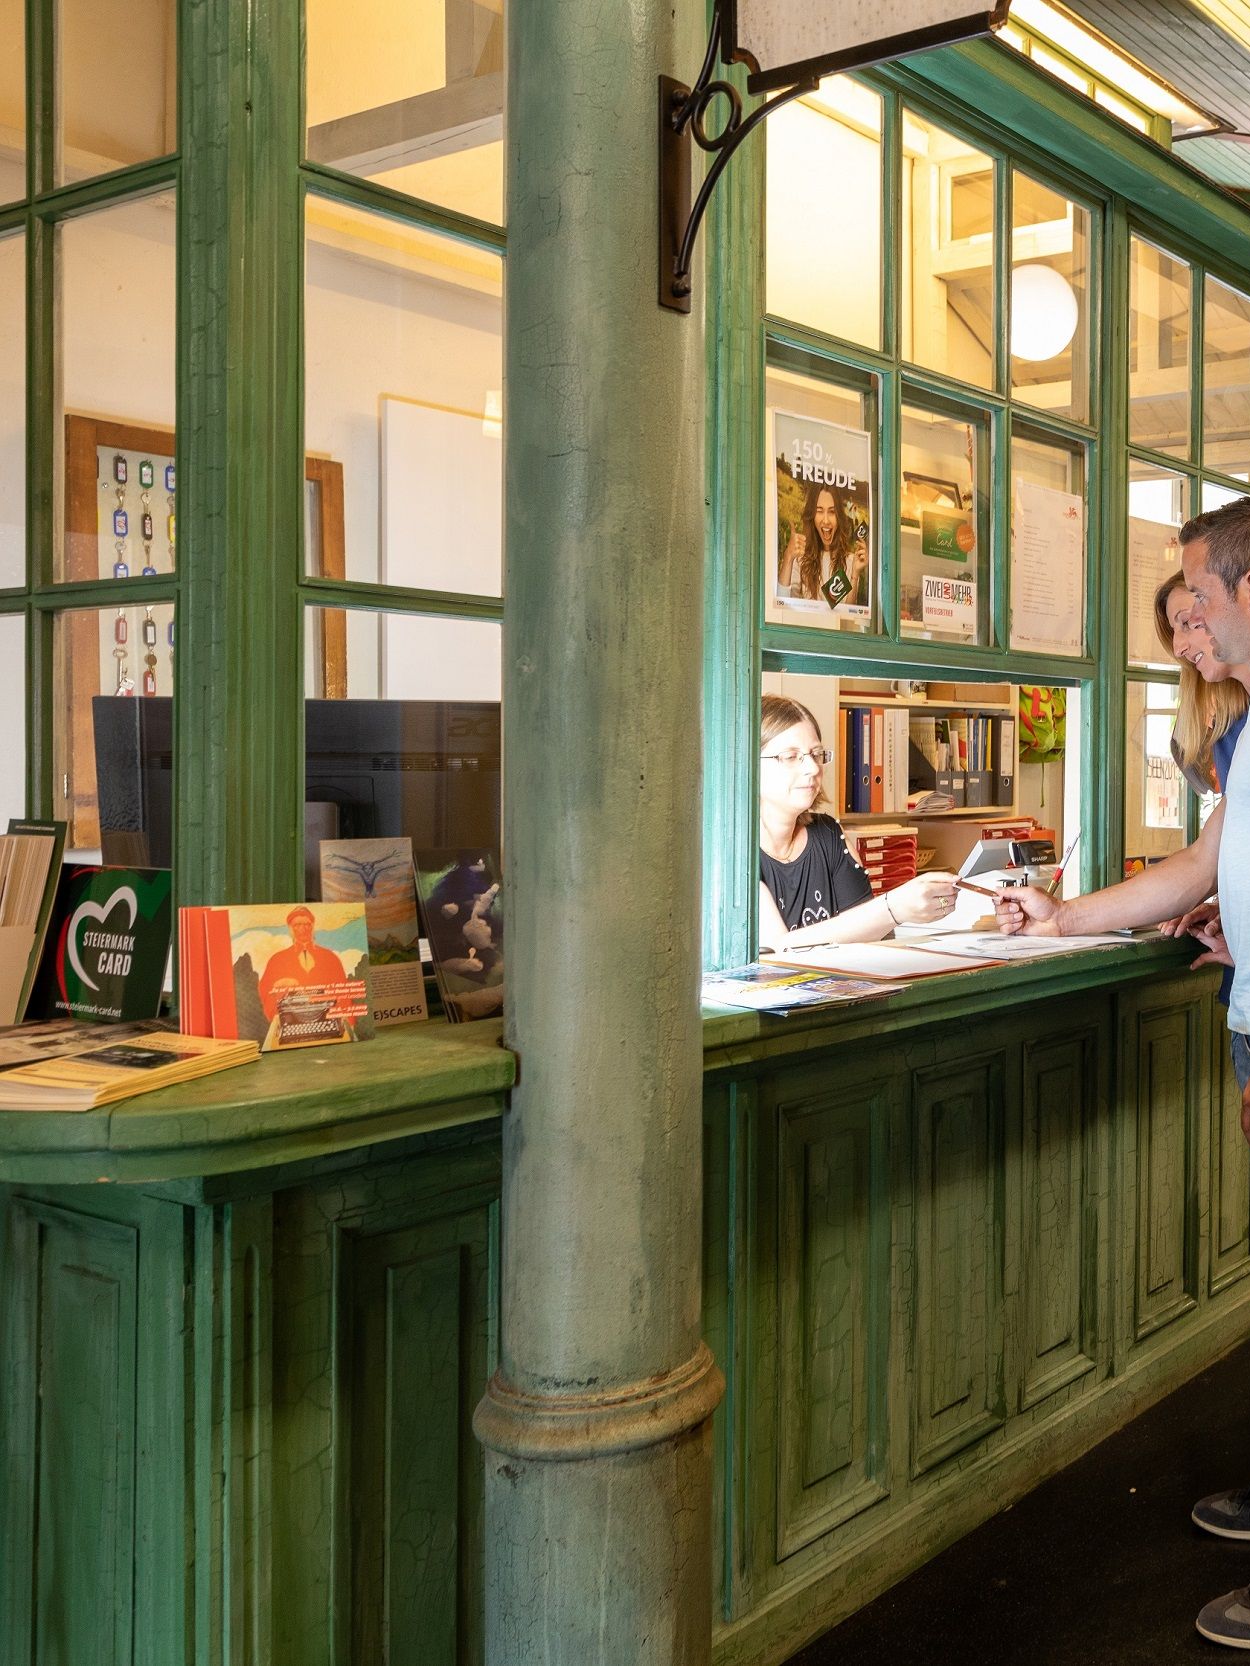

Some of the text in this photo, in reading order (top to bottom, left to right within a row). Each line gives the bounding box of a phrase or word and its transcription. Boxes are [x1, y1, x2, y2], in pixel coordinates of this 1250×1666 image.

[791, 437, 823, 462] 150
[790, 459, 857, 491] FREUDE
[925, 580, 943, 599] ZWEI
[83, 932, 136, 952] STEIERMARK
[97, 952, 132, 976] CARD
[55, 1001, 122, 1018] www.steiermark-card.net
